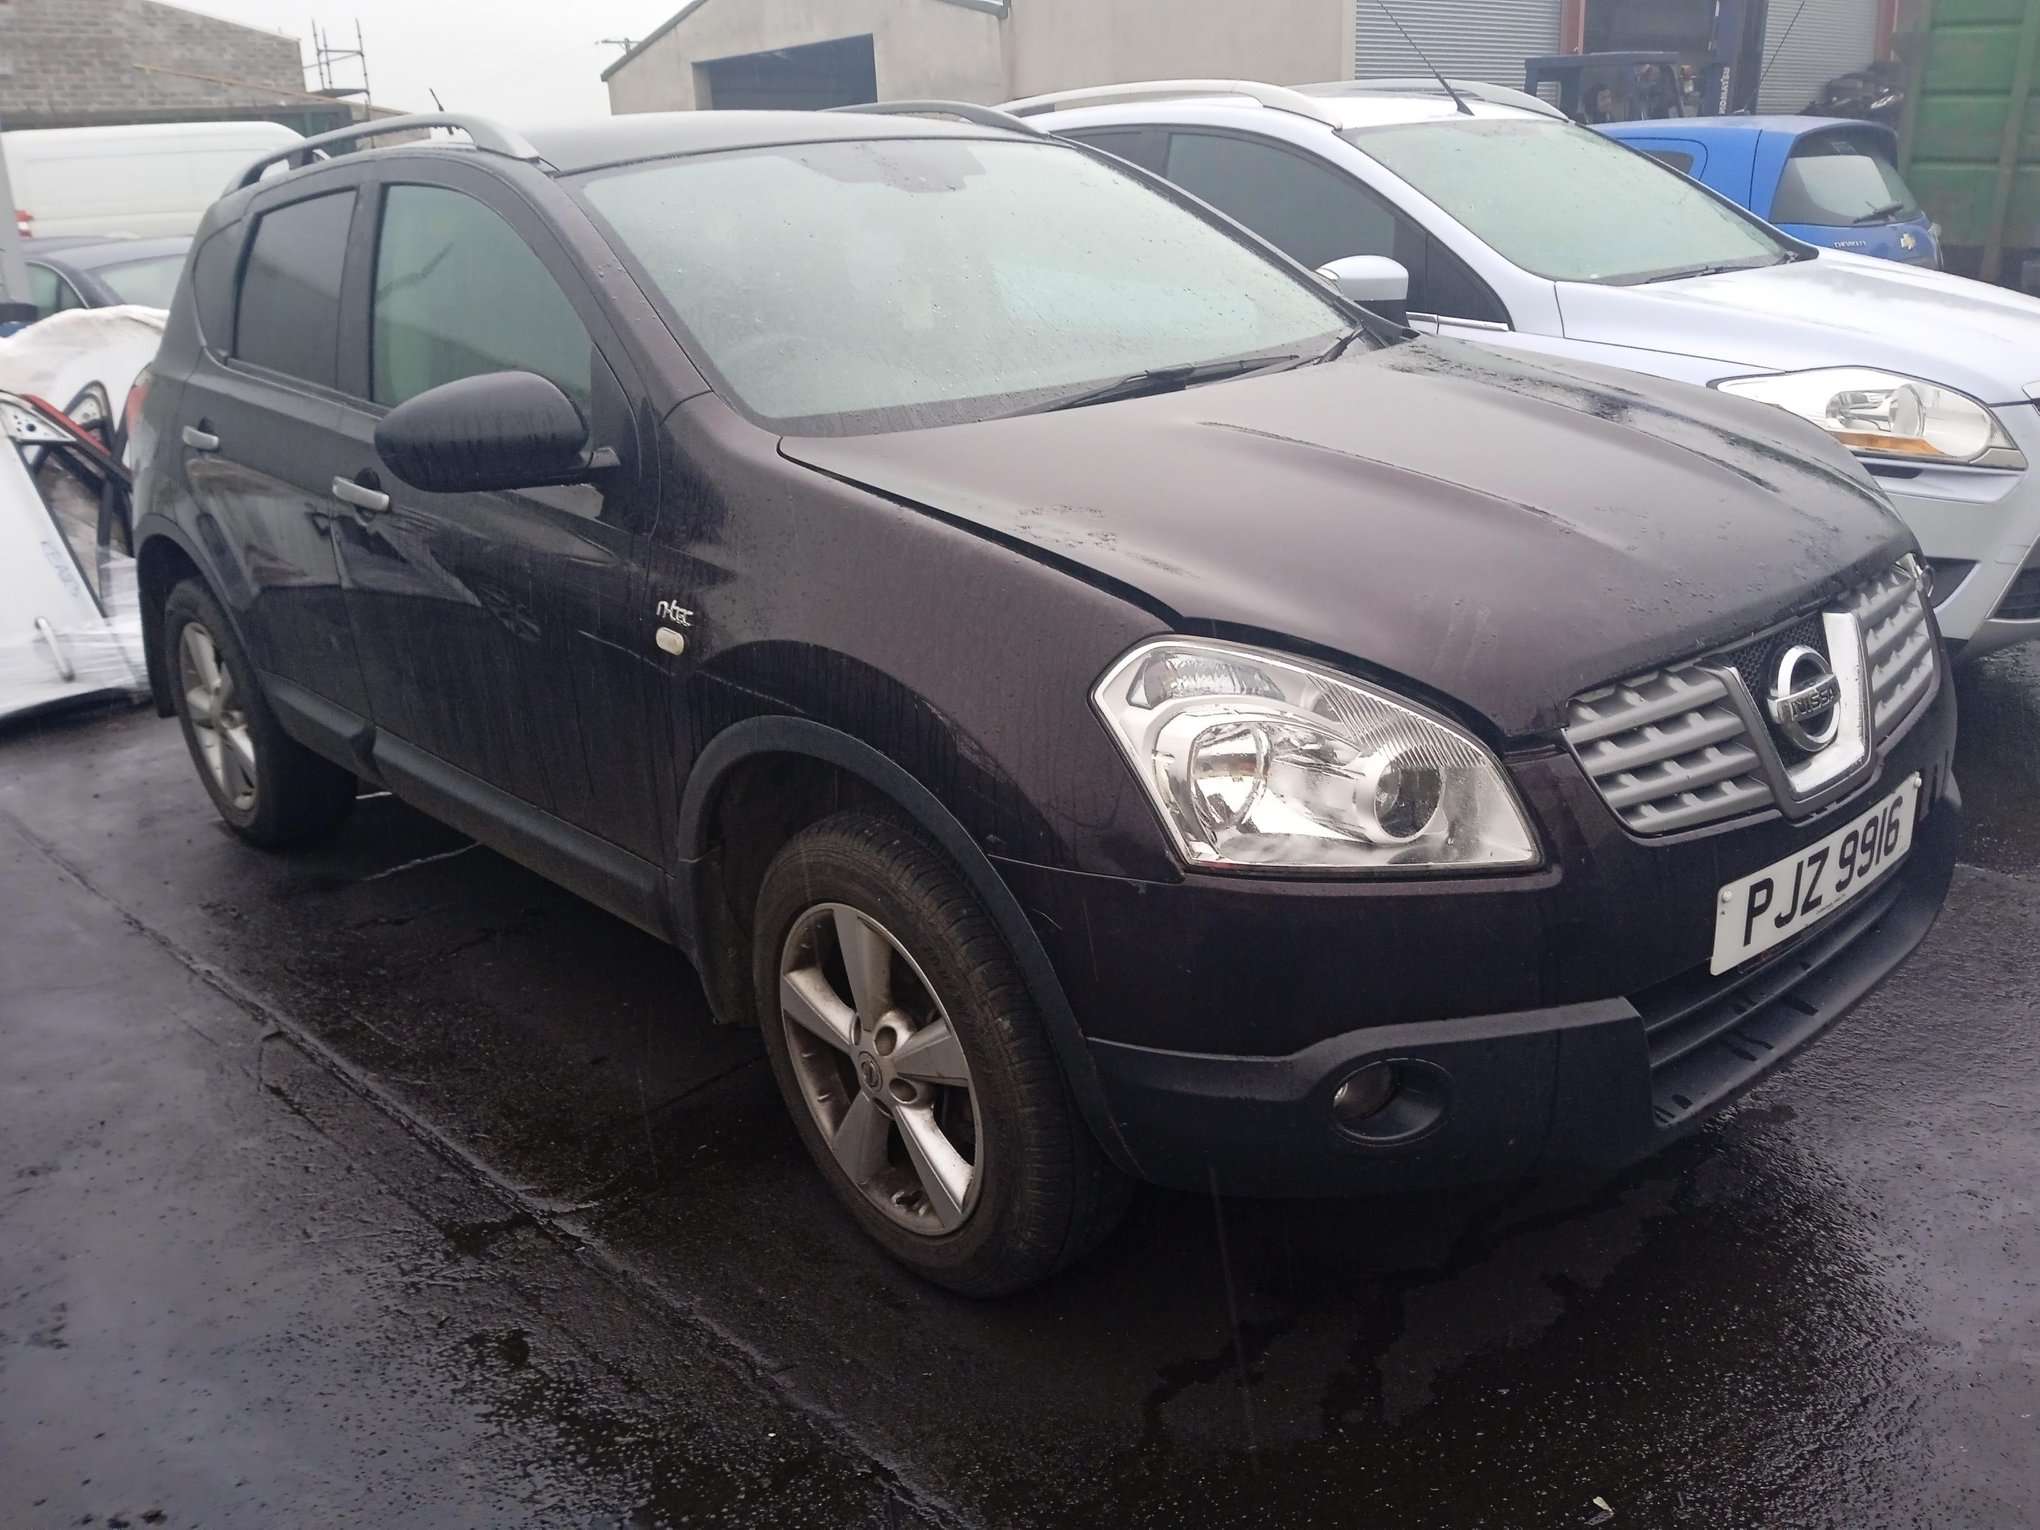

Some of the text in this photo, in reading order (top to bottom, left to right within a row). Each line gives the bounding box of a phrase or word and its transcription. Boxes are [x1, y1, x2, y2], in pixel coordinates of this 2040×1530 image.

[1790, 687, 1834, 719] NISSA
[1743, 796, 1904, 947] PJZ 9916
